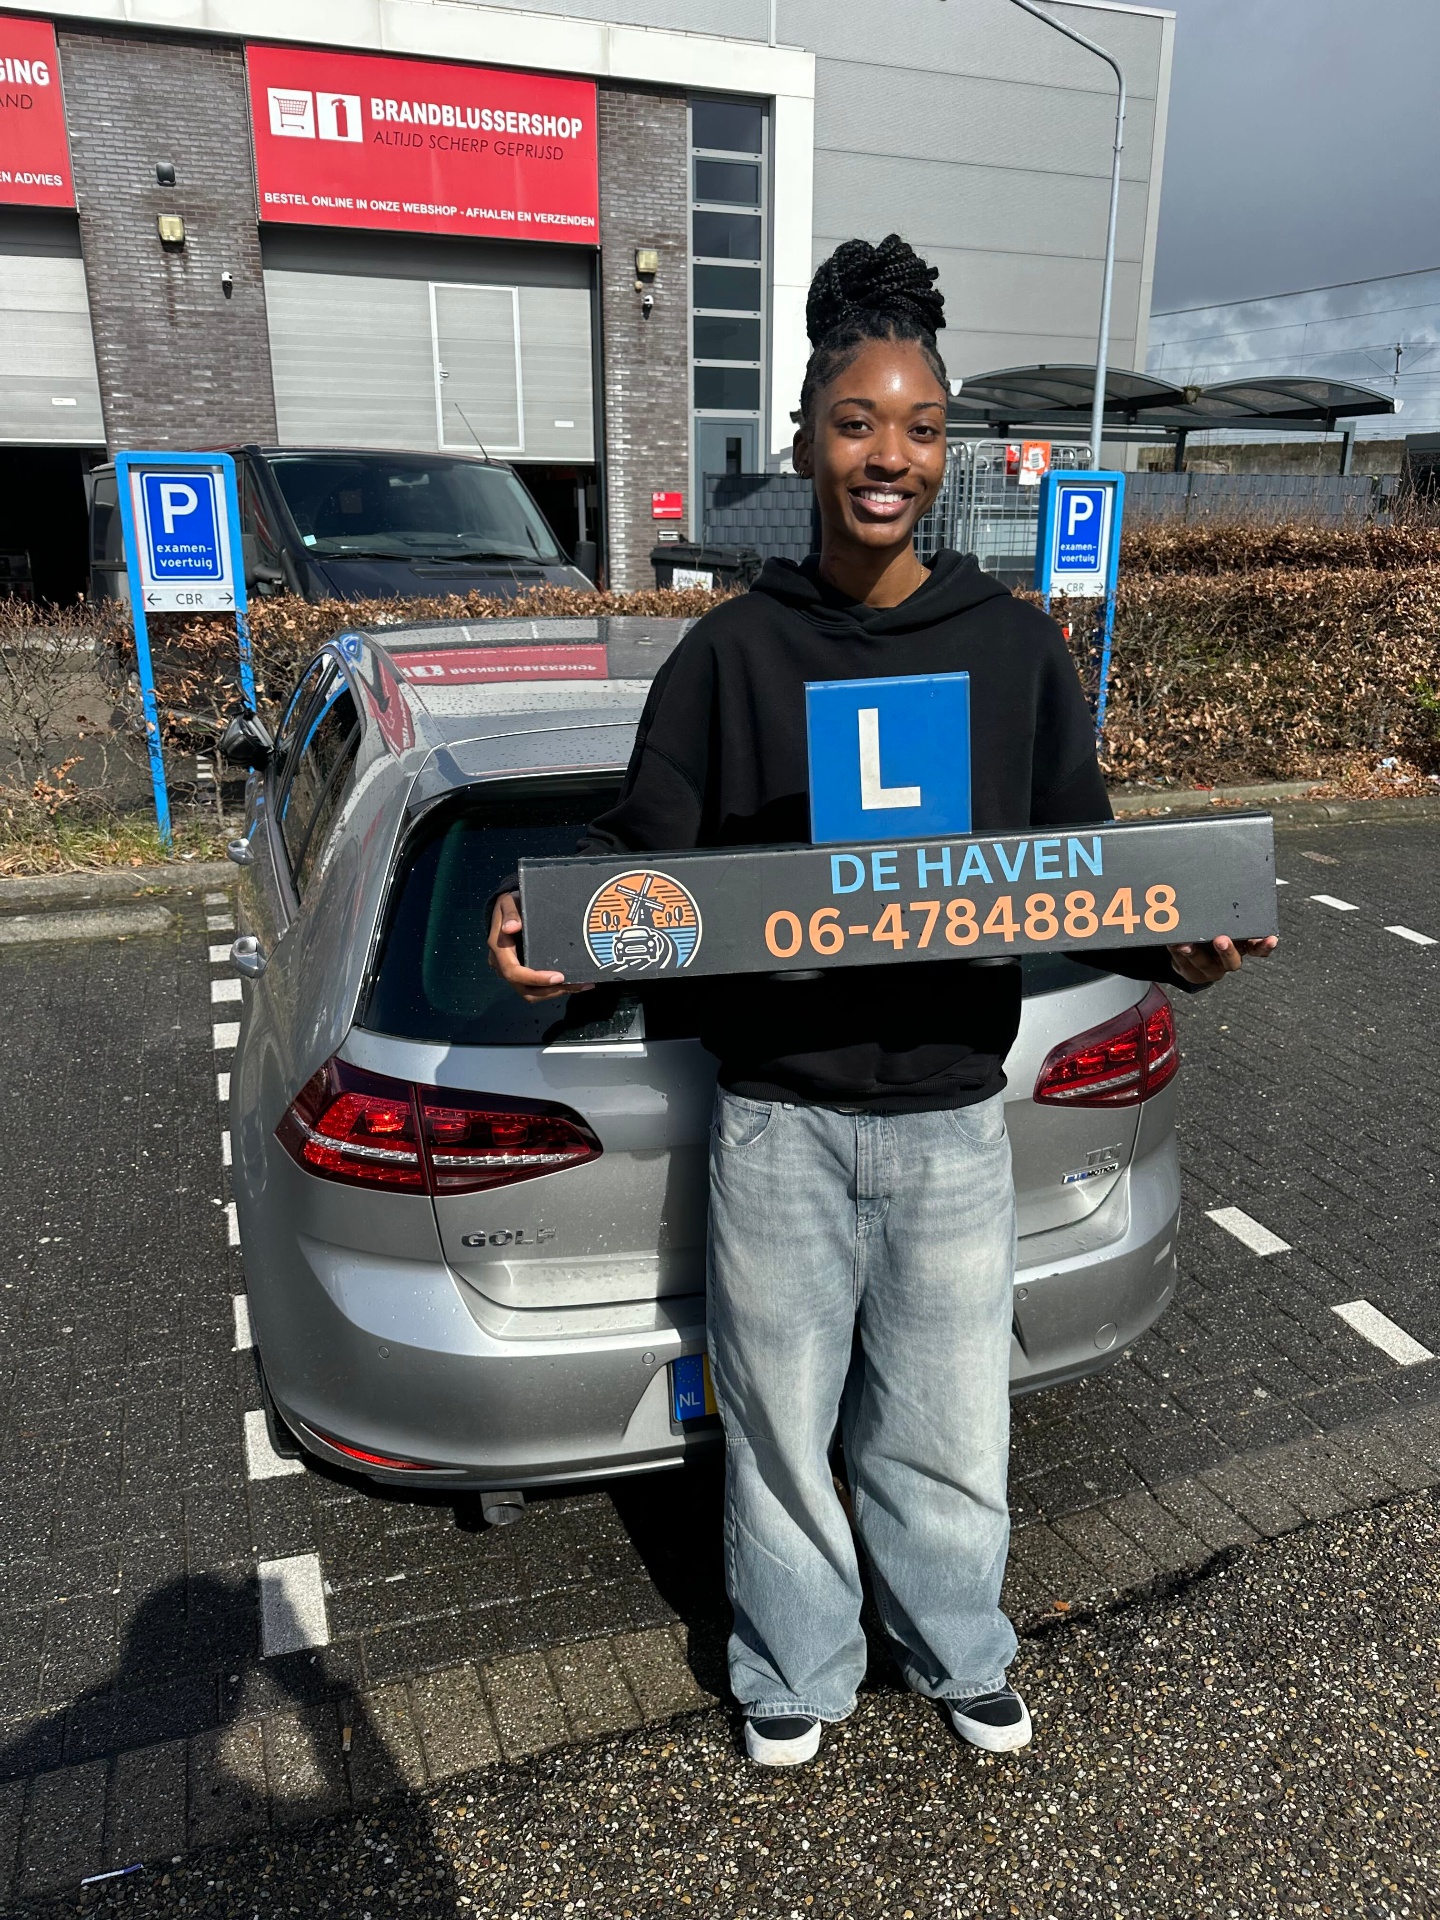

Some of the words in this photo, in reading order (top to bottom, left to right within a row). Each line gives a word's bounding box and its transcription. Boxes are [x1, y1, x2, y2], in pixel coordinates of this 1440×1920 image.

[370, 97, 583, 139] BRANDBLUSSERSHOP
[373, 131, 423, 148] ALTIJD
[428, 135, 489, 153] SCHERP
[493, 141, 564, 161] GEPRIJSD
[0, 171, 12, 183] N
[14, 172, 63, 187] ADVIES
[264, 192, 309, 206] BESTEL
[311, 195, 354, 209] ONLINE
[356, 198, 368, 209] IN
[370, 200, 400, 212] ONZE
[402, 202, 457, 216] WEBSHOP
[466, 207, 515, 221] AFHALEN
[517, 211, 532, 222] EN
[534, 213, 595, 227] VERZENDEN
[159, 483, 198, 534] P
[1067, 495, 1094, 536] P
[156, 544, 213, 553] examen-
[1060, 543, 1097, 551] examen-
[160, 557, 213, 570] voertuig
[1061, 554, 1095, 565] voertuig
[1066, 582, 1085, 592] CBR
[175, 593, 203, 605] CBR
[857, 707, 922, 810] L
[830, 851, 901, 895] DE
[916, 836, 1103, 889] HAVEN
[764, 884, 1180, 958] 06-47848848
[461, 1227, 557, 1247] GOLF
[679, 1391, 701, 1408] NL
